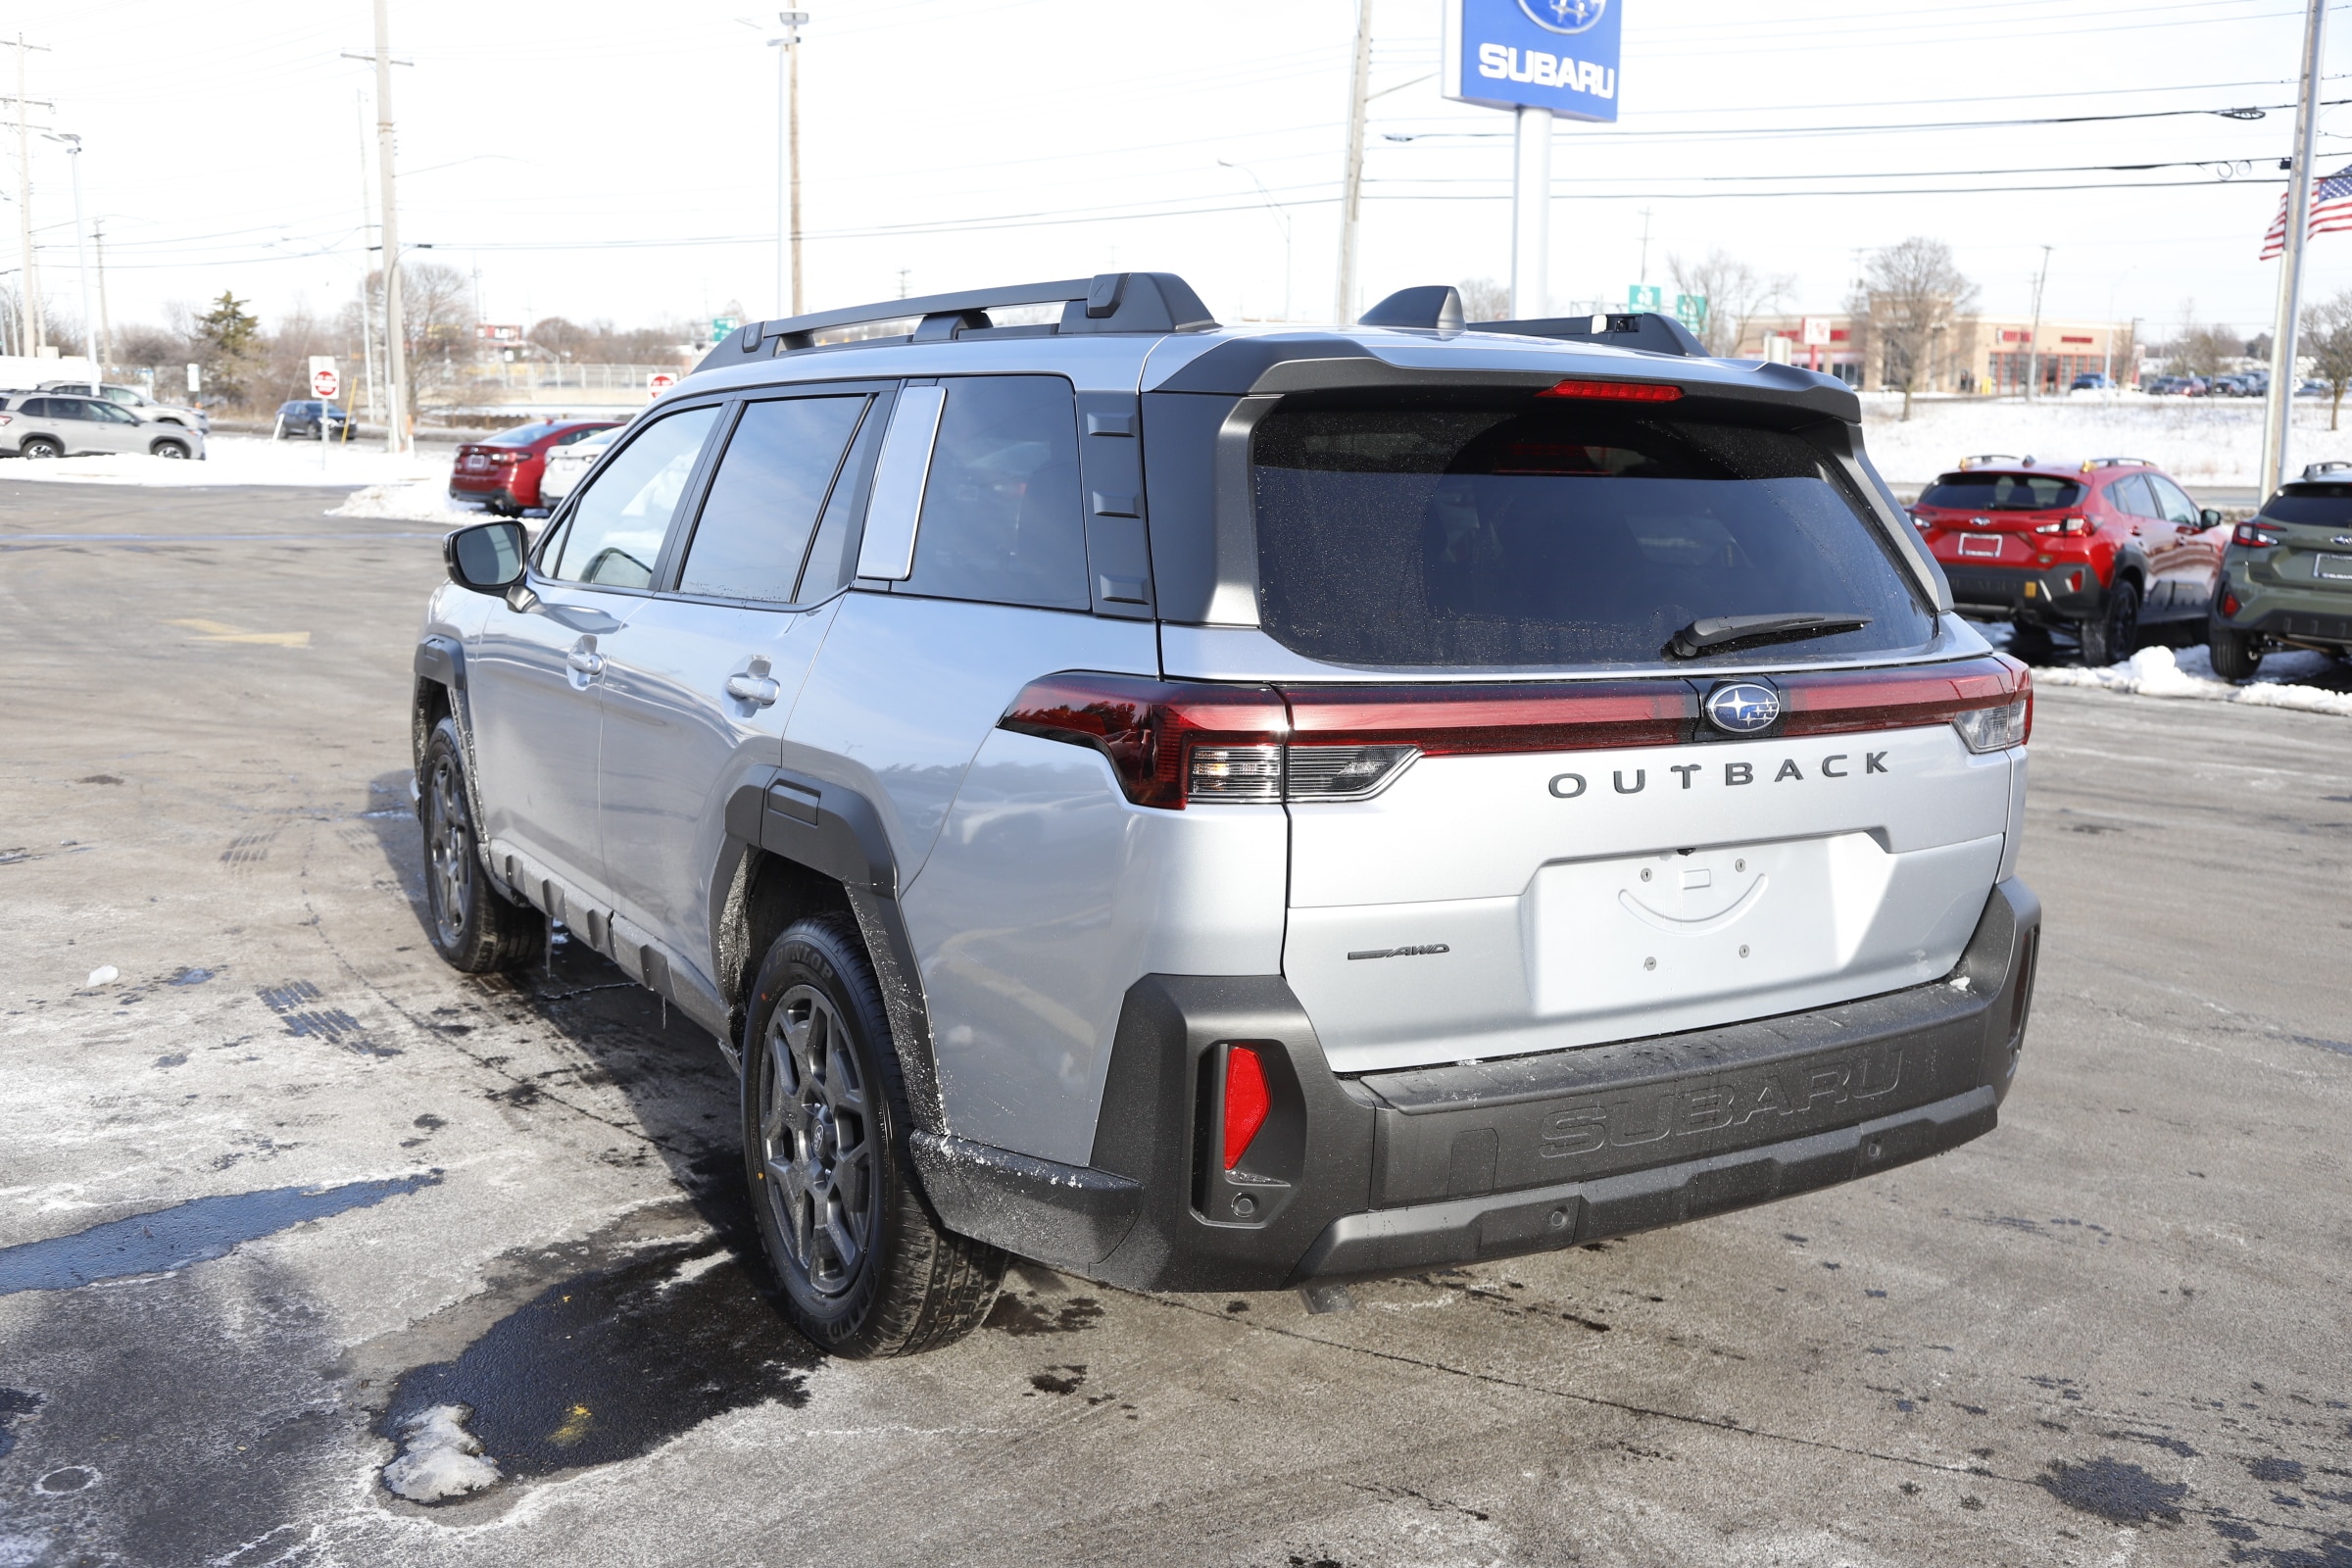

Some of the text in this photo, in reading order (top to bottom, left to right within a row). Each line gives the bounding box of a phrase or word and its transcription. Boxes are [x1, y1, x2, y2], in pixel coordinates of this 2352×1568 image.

[1478, 42, 1615, 100] SUBARU
[1547, 751, 1889, 799] OUTBACK
[1385, 943, 1450, 957] AWD
[1539, 1050, 1903, 1159] SUBARU
